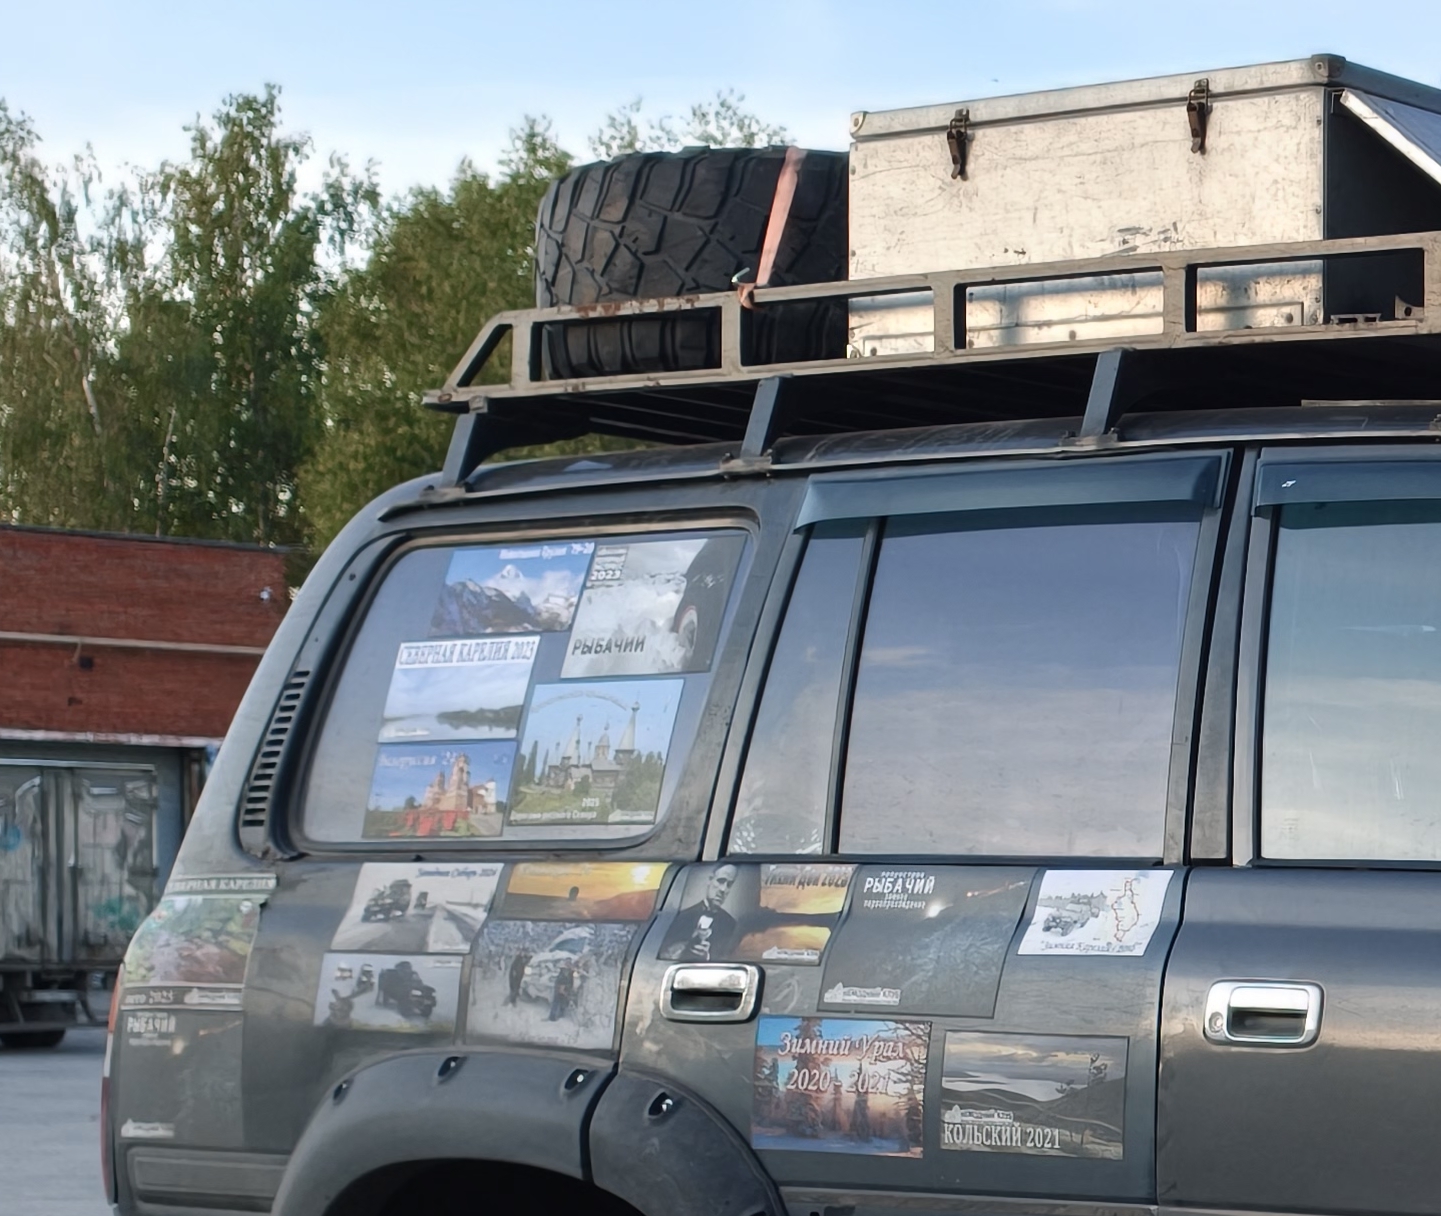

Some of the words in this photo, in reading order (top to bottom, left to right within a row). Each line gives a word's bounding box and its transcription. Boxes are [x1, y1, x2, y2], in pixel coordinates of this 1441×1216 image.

[863, 876, 935, 894] РЫБАЧИЙ
[778, 1031, 851, 1057] Зимний
[856, 1034, 906, 1065] Урал
[786, 1068, 831, 1092] 2020
[944, 1121, 1021, 1148] КОЛЬСКИЙ
[1026, 1127, 1061, 1149] 2021
